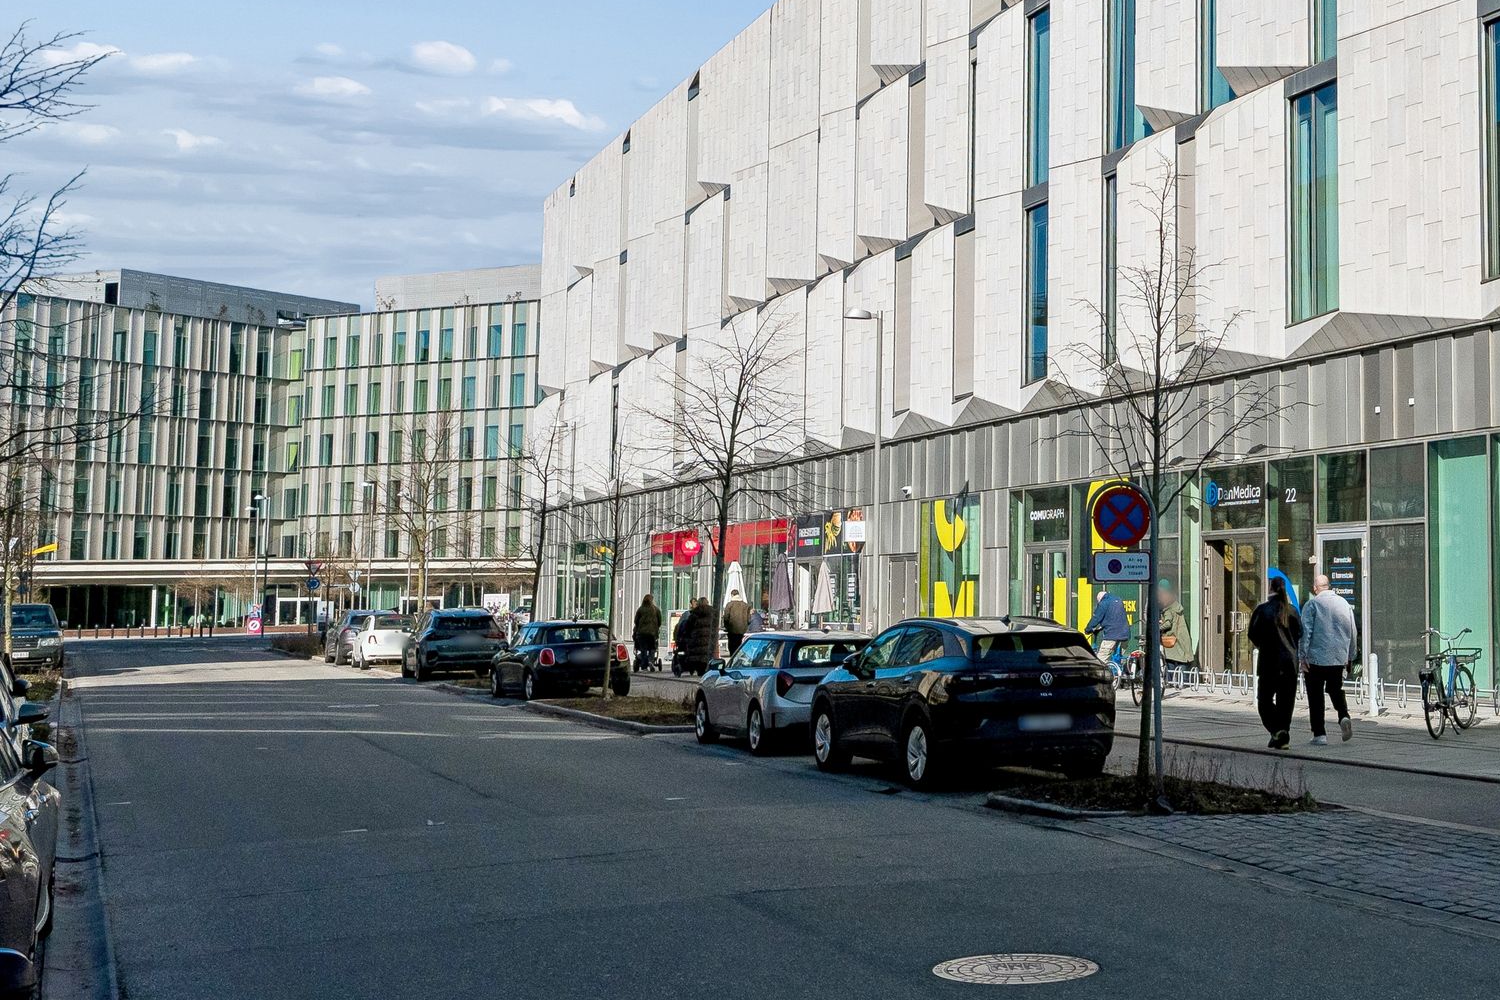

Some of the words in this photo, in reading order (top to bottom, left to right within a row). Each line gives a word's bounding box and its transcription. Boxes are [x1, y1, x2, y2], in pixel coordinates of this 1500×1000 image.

[1217, 484, 1261, 501] DanMedica
[1285, 487, 1297, 503] 22
[1030, 508, 1065, 521] COMUGRAPH
[1123, 600, 1137, 612] FISK
